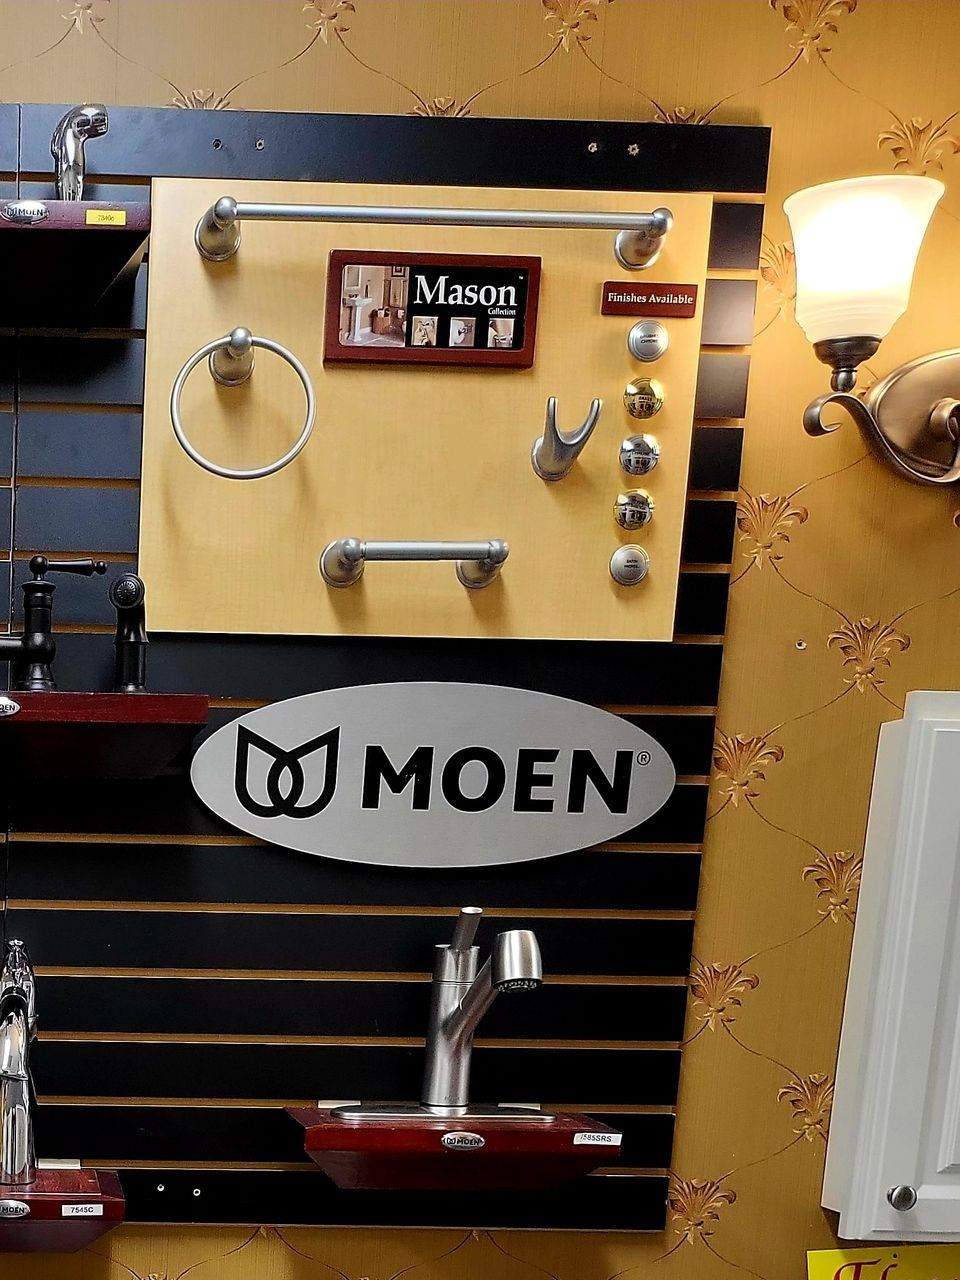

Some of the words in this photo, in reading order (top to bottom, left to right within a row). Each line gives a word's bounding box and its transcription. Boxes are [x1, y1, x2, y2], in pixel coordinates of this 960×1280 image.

[413, 275, 518, 306] Mason
[608, 293, 647, 303] Finishes
[648, 294, 694, 304] Available
[487, 307, 517, 316] Collection
[361, 744, 635, 815] MOEN
[456, 1137, 481, 1146] MOEN
[2, 1206, 26, 1214] MOEN
